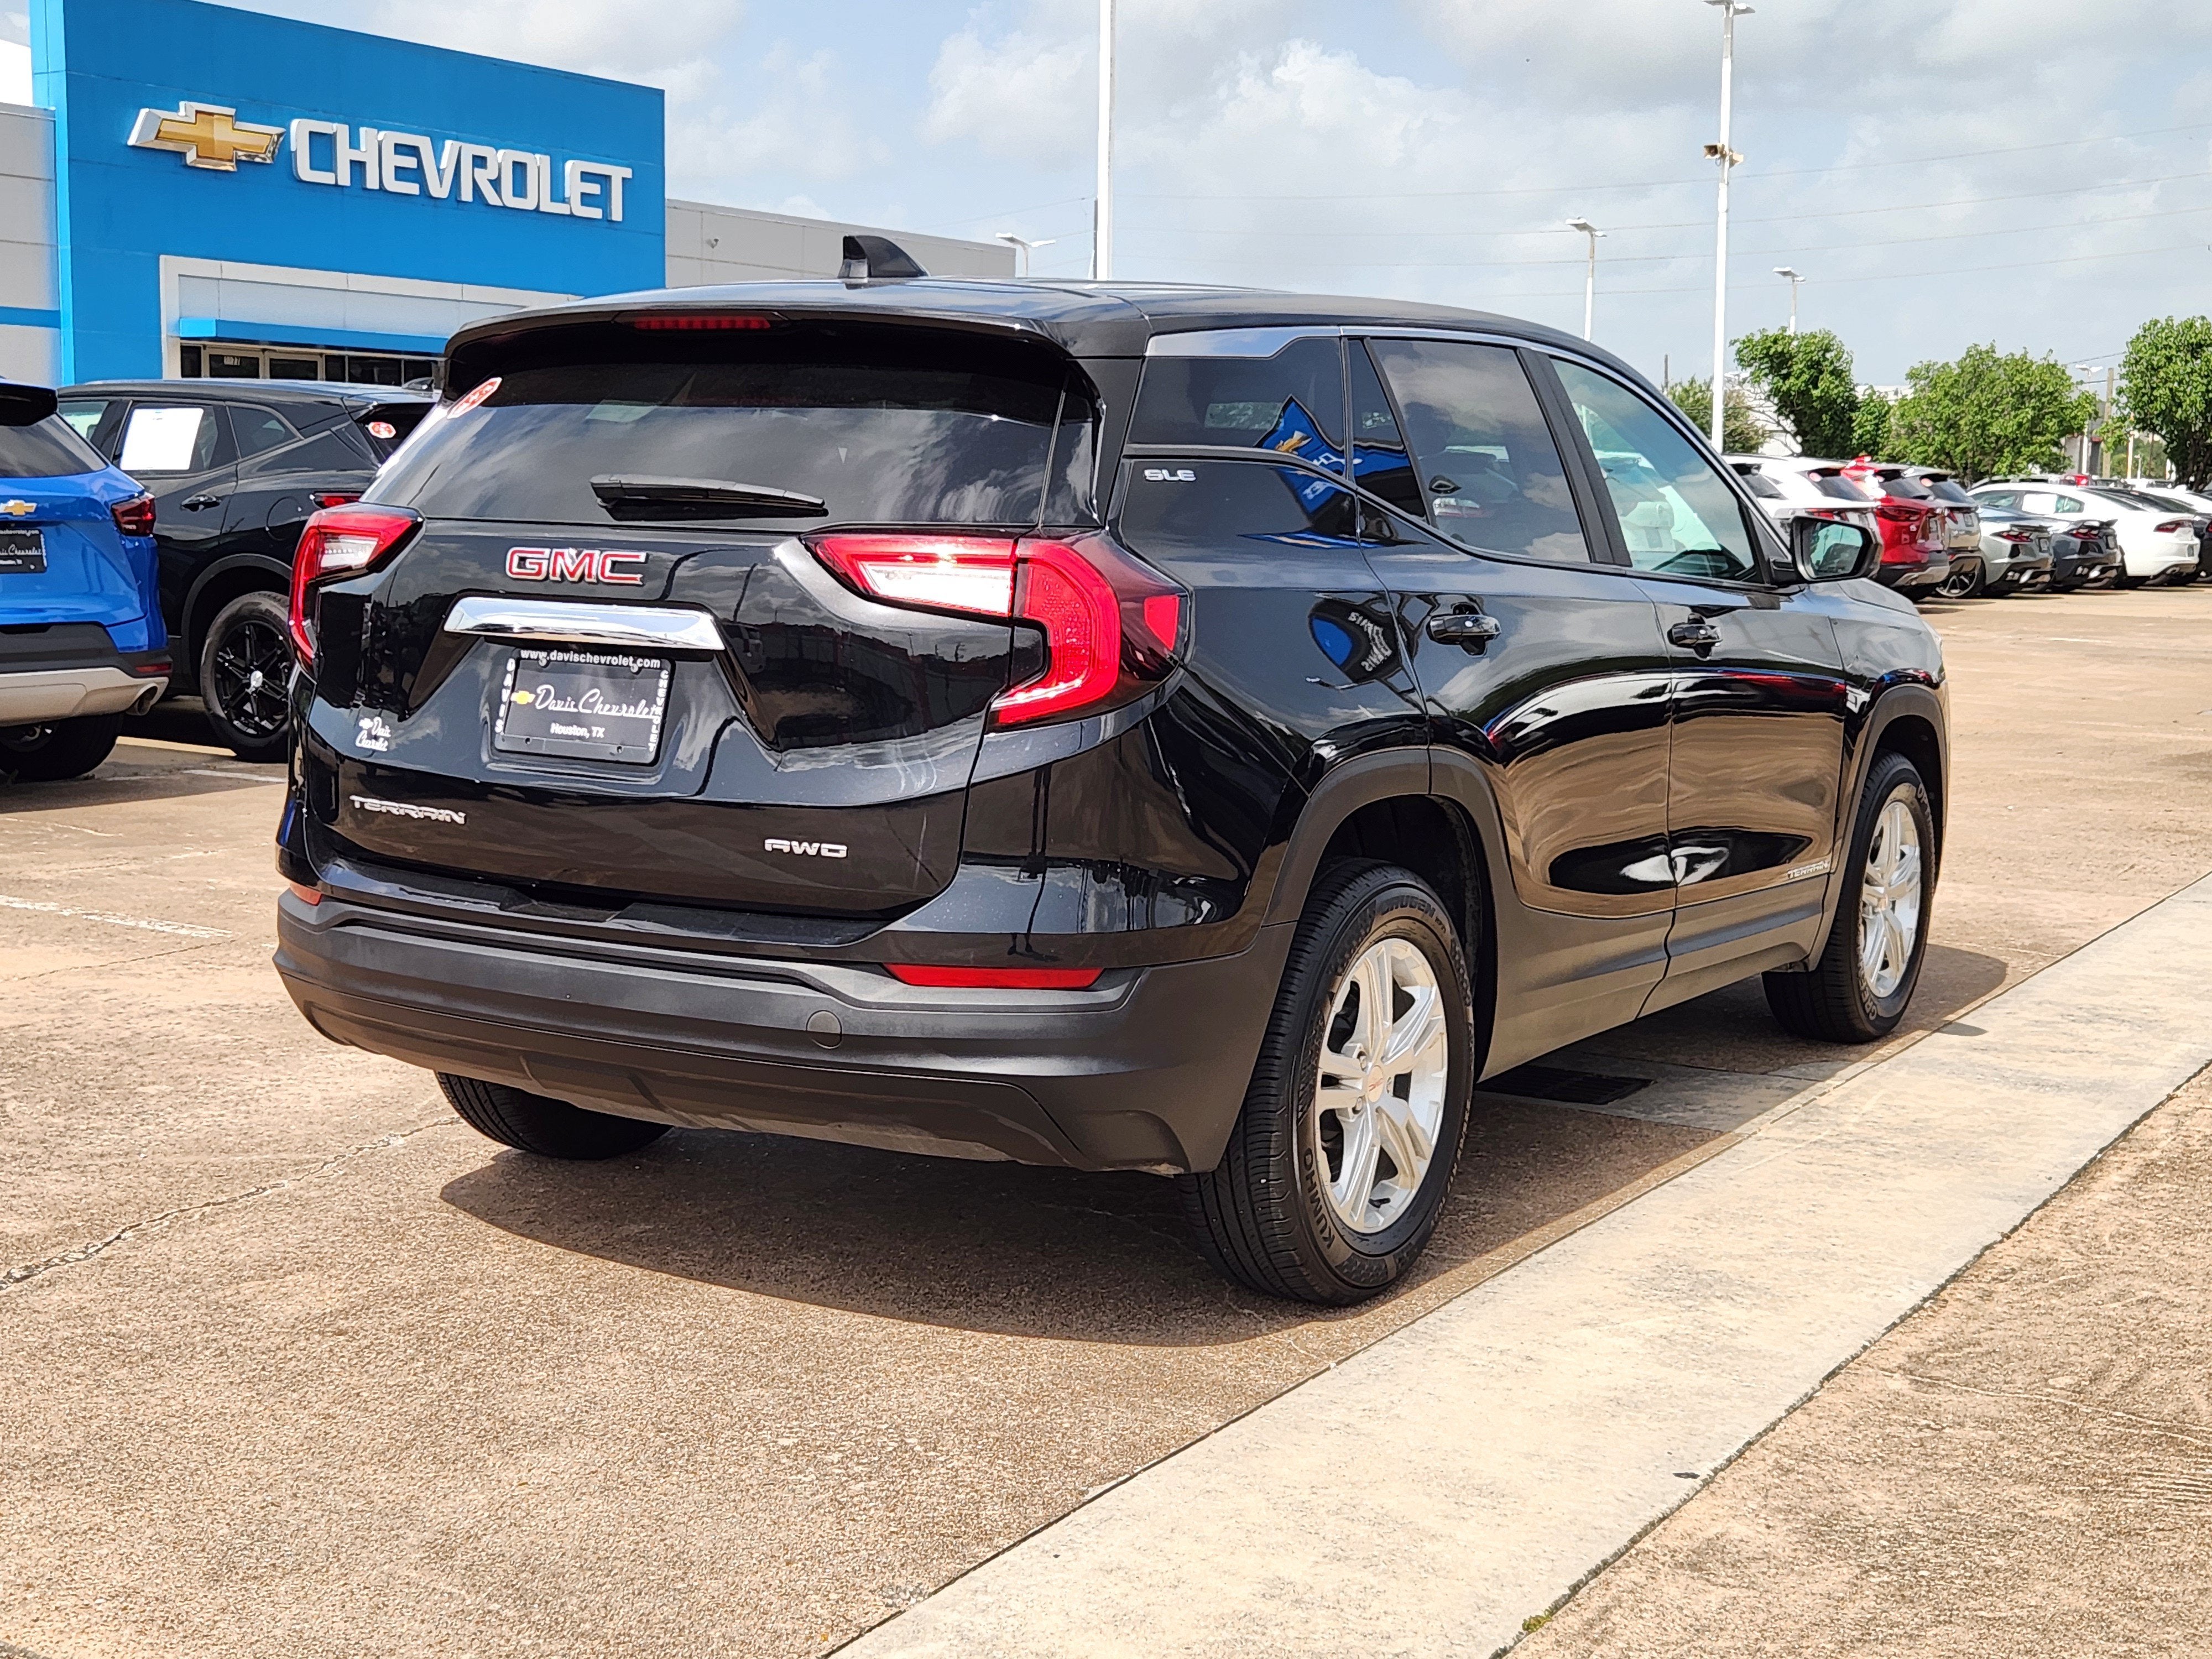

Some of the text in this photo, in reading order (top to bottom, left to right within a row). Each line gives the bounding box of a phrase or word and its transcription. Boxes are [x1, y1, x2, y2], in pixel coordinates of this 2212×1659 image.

[290, 118, 633, 222] CHEVROLET
[1144, 469, 1196, 481] SLE
[505, 546, 647, 585] GMC
[550, 722, 606, 739] Houston, TX
[349, 795, 466, 825] TERRAIN
[764, 838, 848, 858] AWD
[1303, 1147, 1335, 1250] KUMHO
